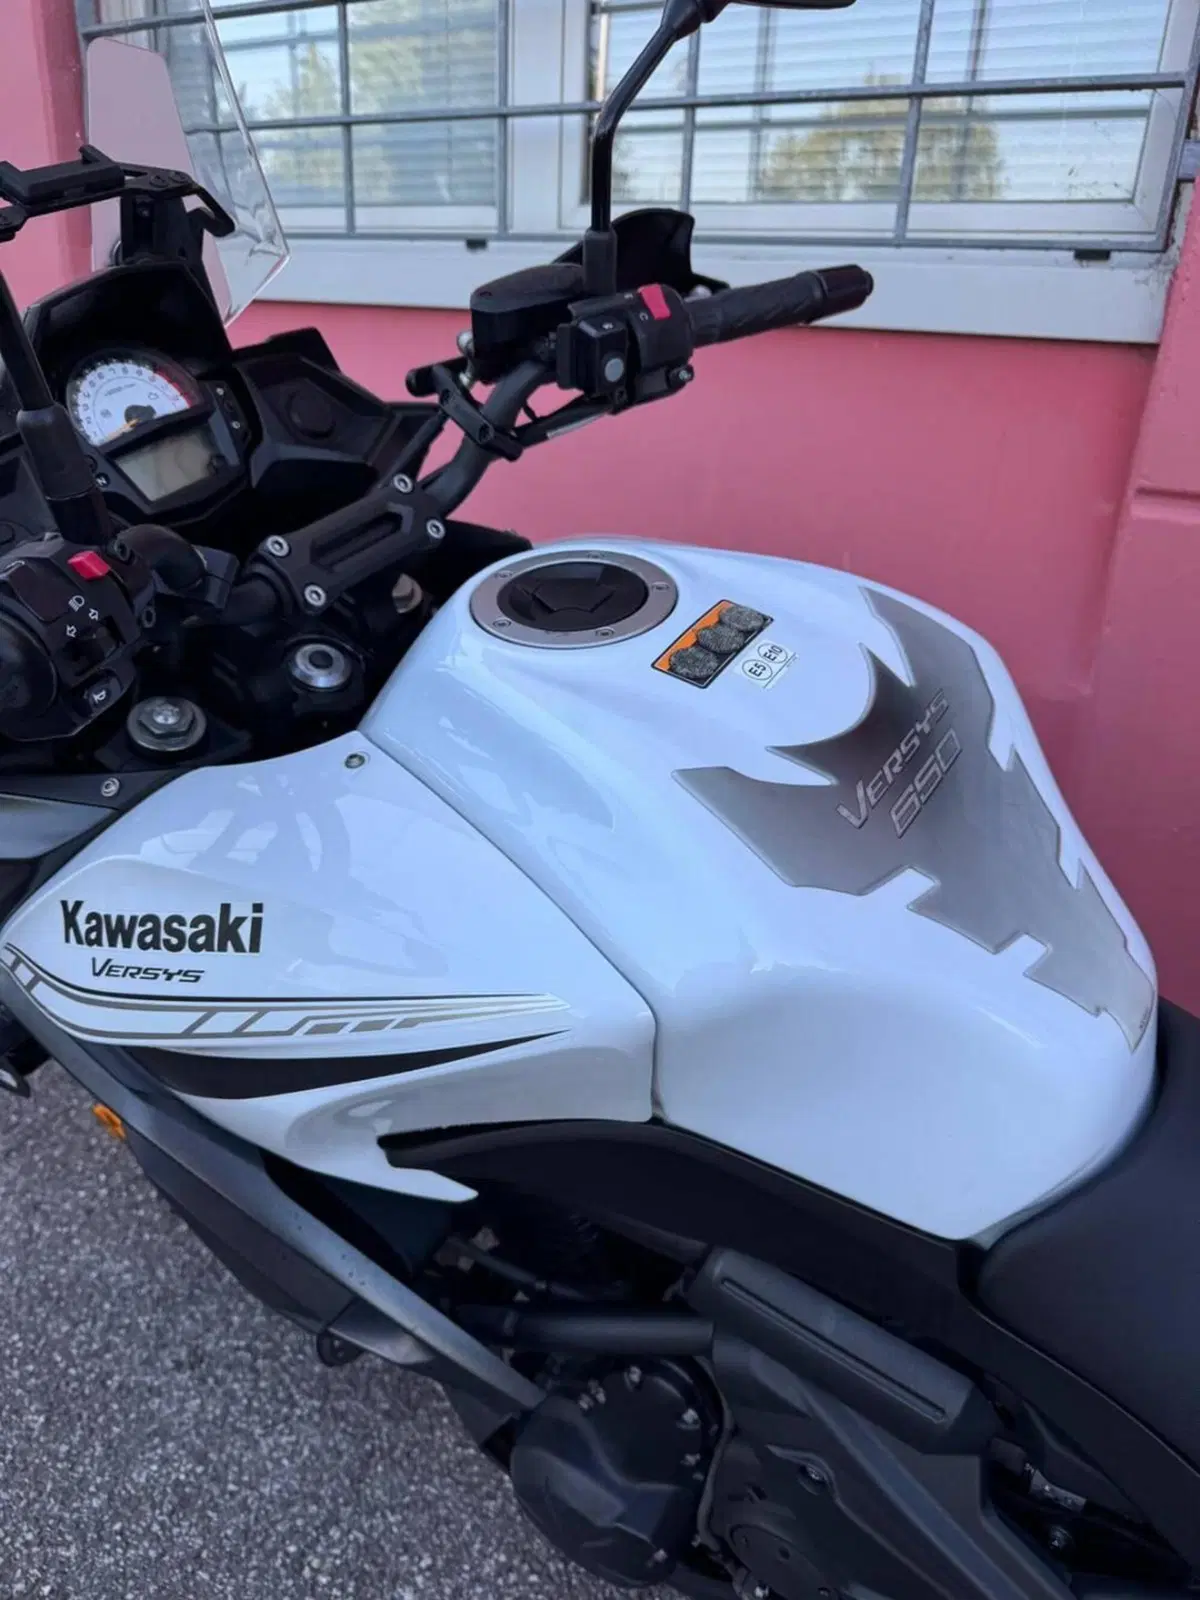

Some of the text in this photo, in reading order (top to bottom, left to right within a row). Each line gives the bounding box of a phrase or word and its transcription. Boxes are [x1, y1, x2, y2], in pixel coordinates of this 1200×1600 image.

[748, 645, 783, 677] E5 E10
[835, 688, 949, 829] VERSYS
[889, 727, 963, 839] 650
[60, 899, 264, 954] Kawasaki
[91, 957, 205, 983] VERSYS
